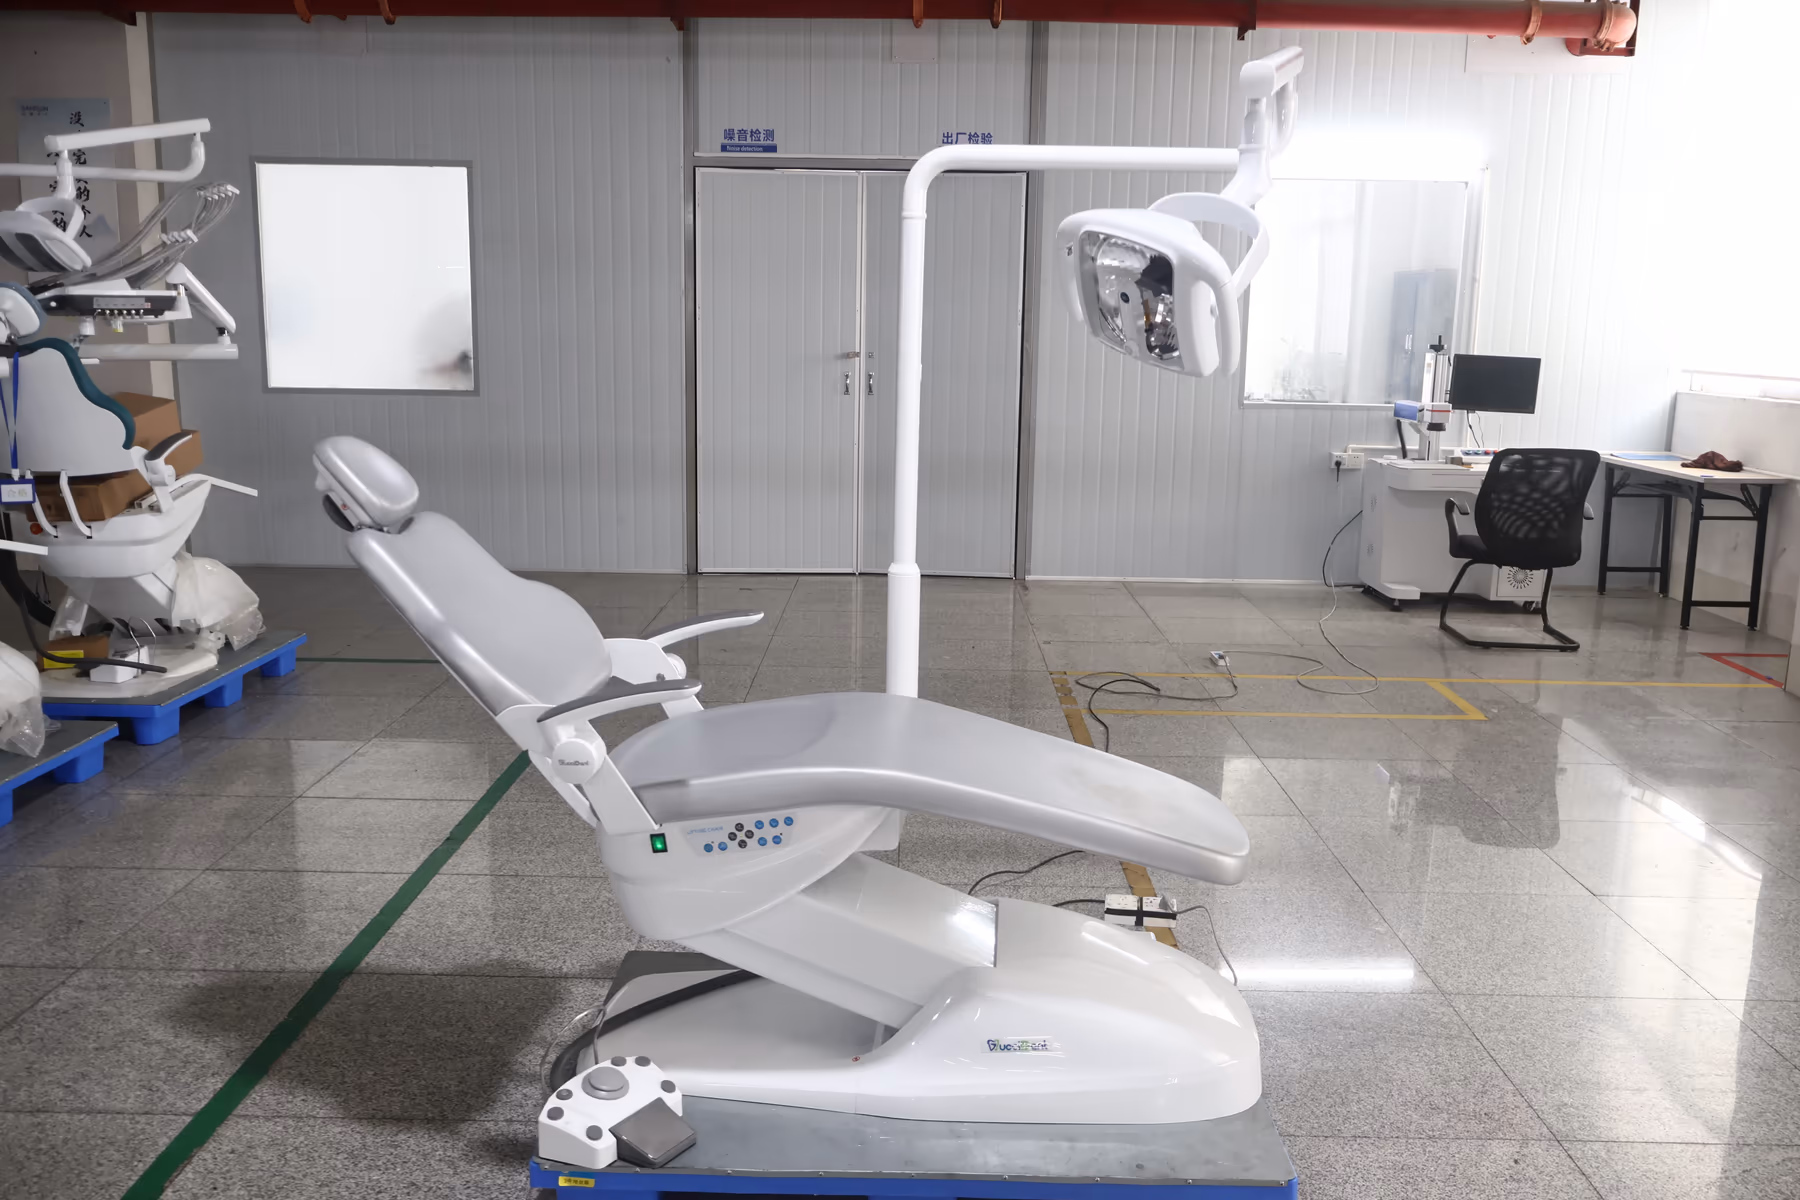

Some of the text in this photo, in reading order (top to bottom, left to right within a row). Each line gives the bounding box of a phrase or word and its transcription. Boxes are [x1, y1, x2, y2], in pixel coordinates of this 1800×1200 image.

[723, 128, 775, 142] 噪音检测
[941, 131, 993, 145] 出厂检验
